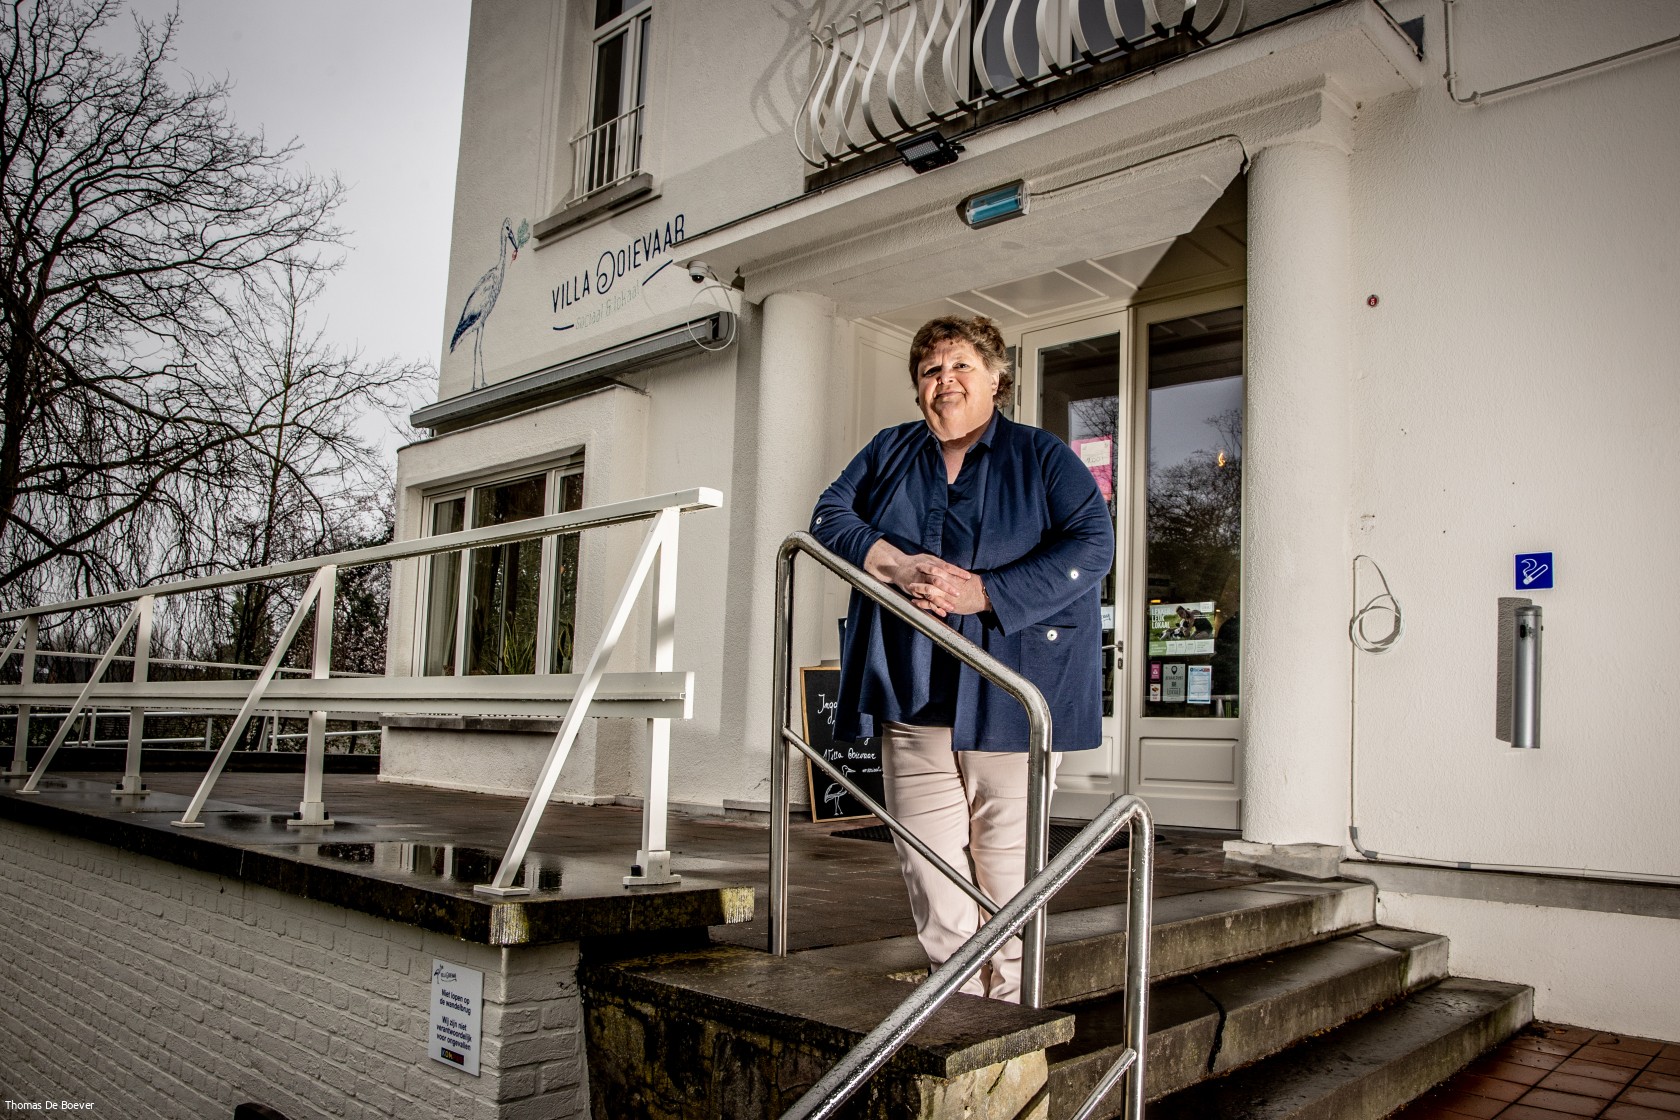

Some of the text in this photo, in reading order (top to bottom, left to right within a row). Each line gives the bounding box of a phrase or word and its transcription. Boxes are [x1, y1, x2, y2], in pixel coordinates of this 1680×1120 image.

[552, 270, 590, 313] VILLA
[441, 988, 470, 1006] Niet lopen op
[439, 998, 472, 1016] de wandelbrug
[436, 1024, 472, 1043] verantwoordelijk
[449, 1019, 458, 1029] zijn
[458, 1022, 467, 1031] niet
[436, 1033, 472, 1051] voor ongevallen
